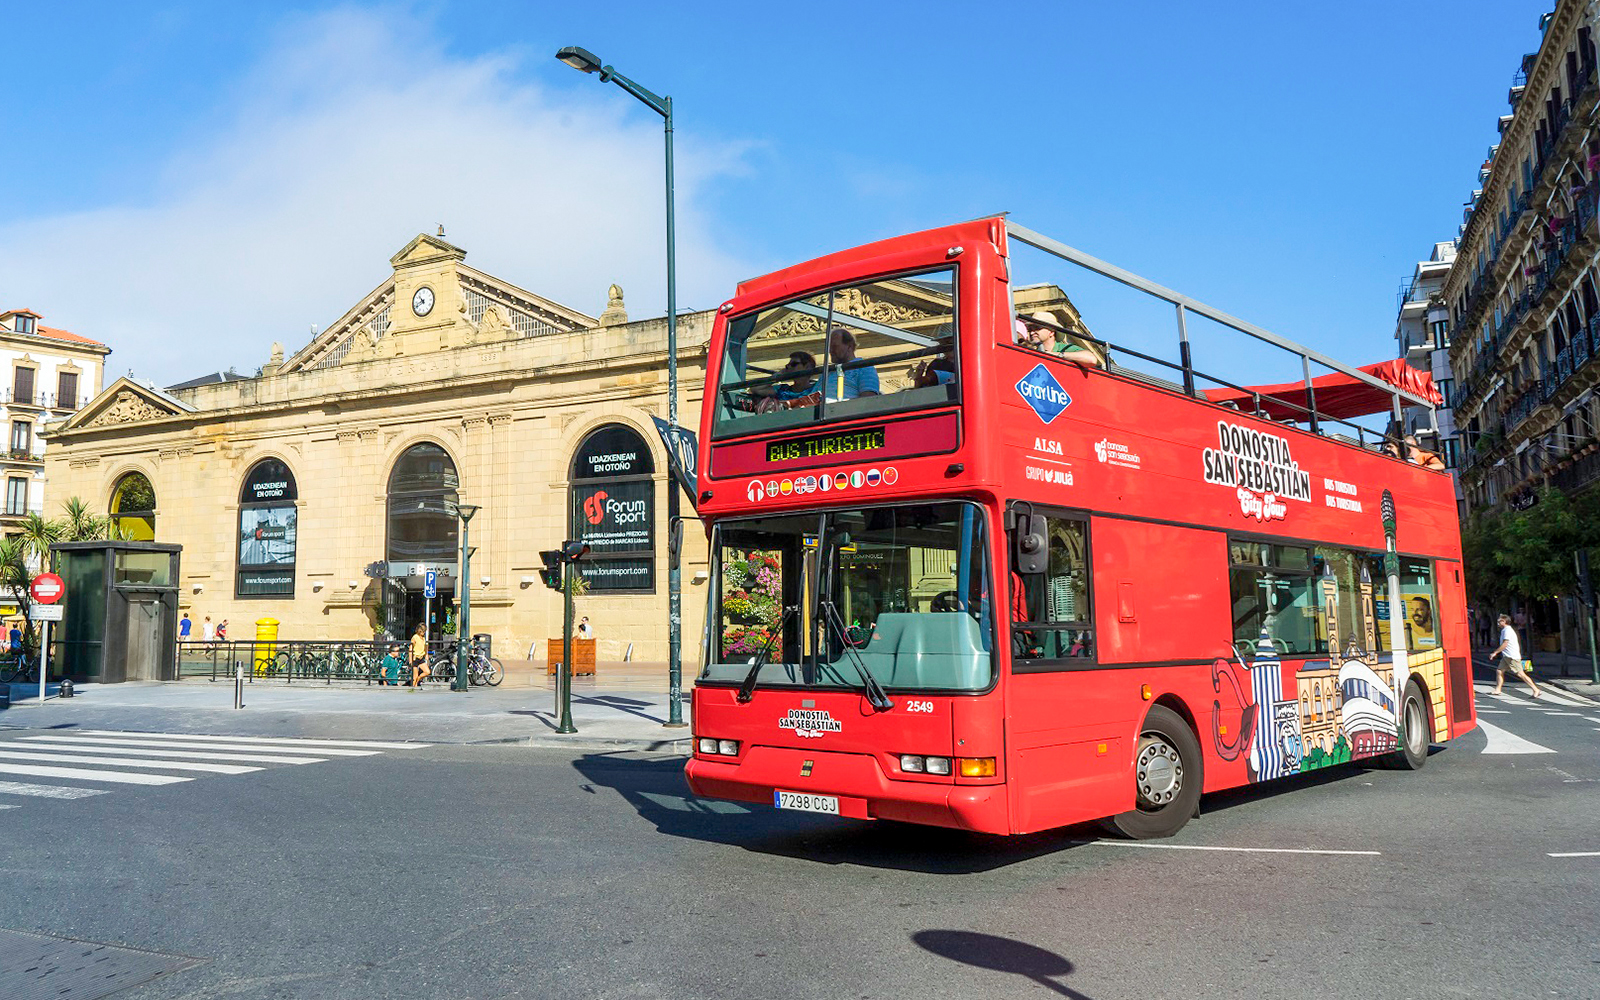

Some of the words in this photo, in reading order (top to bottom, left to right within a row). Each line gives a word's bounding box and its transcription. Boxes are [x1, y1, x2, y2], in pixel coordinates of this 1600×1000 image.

[770, 443, 800, 462] BUS
[805, 431, 883, 457] TURISTIC
[1034, 437, 1063, 456] ALSA
[1219, 422, 1292, 468] DONOSTIA
[588, 452, 636, 464] UDAZKENEAN
[593, 464, 604, 473] EN
[605, 461, 631, 472] OTOÑO
[1025, 465, 1045, 482] GRUPO
[1204, 449, 1237, 486] SAN
[1238, 458, 1310, 500] SEBASTIÁN
[253, 481, 288, 491] UDAZKENEAN
[1323, 477, 1335, 491] BUS
[256, 490, 265, 498] EN
[265, 489, 283, 497] OTOÑO
[1237, 487, 1262, 519] City
[1263, 494, 1288, 519] Tour
[1325, 494, 1336, 508] BUS
[614, 510, 646, 526] sport
[428, 573, 435, 584] P
[582, 567, 648, 577] www.forumsport.com
[245, 576, 292, 585] www.forumsport.com
[906, 700, 934, 713] 2549
[788, 709, 830, 721] DONOSTIA
[779, 718, 795, 728] SAN
[796, 718, 841, 731] SEBASTIÁN
[781, 793, 810, 809] 7298
[813, 796, 836, 812] CGJ
